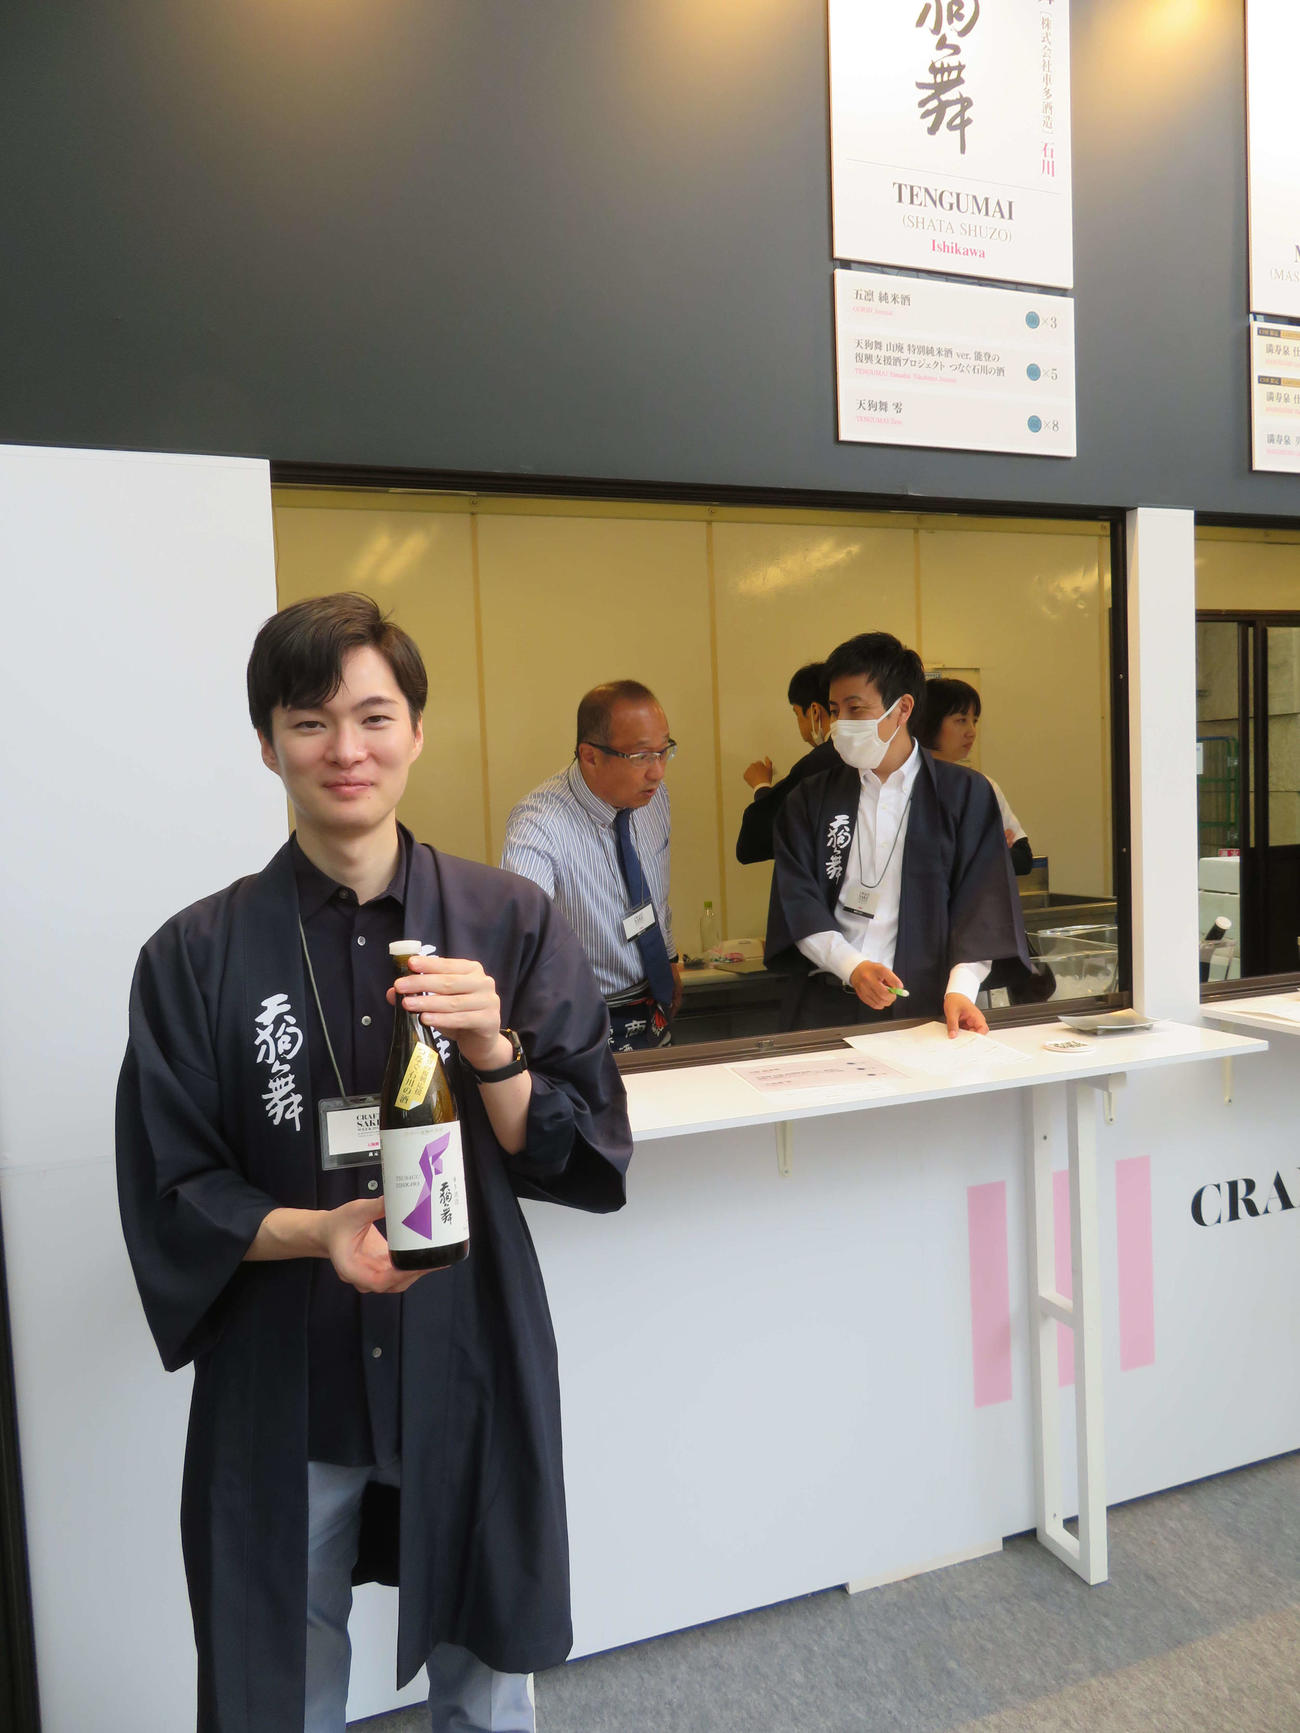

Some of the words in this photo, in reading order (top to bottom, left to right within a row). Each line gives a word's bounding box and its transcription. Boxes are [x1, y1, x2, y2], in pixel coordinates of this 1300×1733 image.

[1041, 142, 1056, 178] 石川
[892, 181, 1015, 221] TENGUMAI
[902, 213, 955, 234] (SHATA
[959, 222, 1013, 243] SHUZO)
[930, 238, 986, 259] Ishikawa
[878, 291, 911, 306] 純米酒
[855, 338, 883, 352] 天狗舞
[906, 343, 953, 359] 特別純米酒
[973, 350, 1000, 363] 能登の
[856, 399, 888, 413] 天狗舞
[825, 814, 851, 885] 天狗舞
[254, 993, 304, 1132] 天狗舞
[1191, 1169, 1300, 1227] CRA
